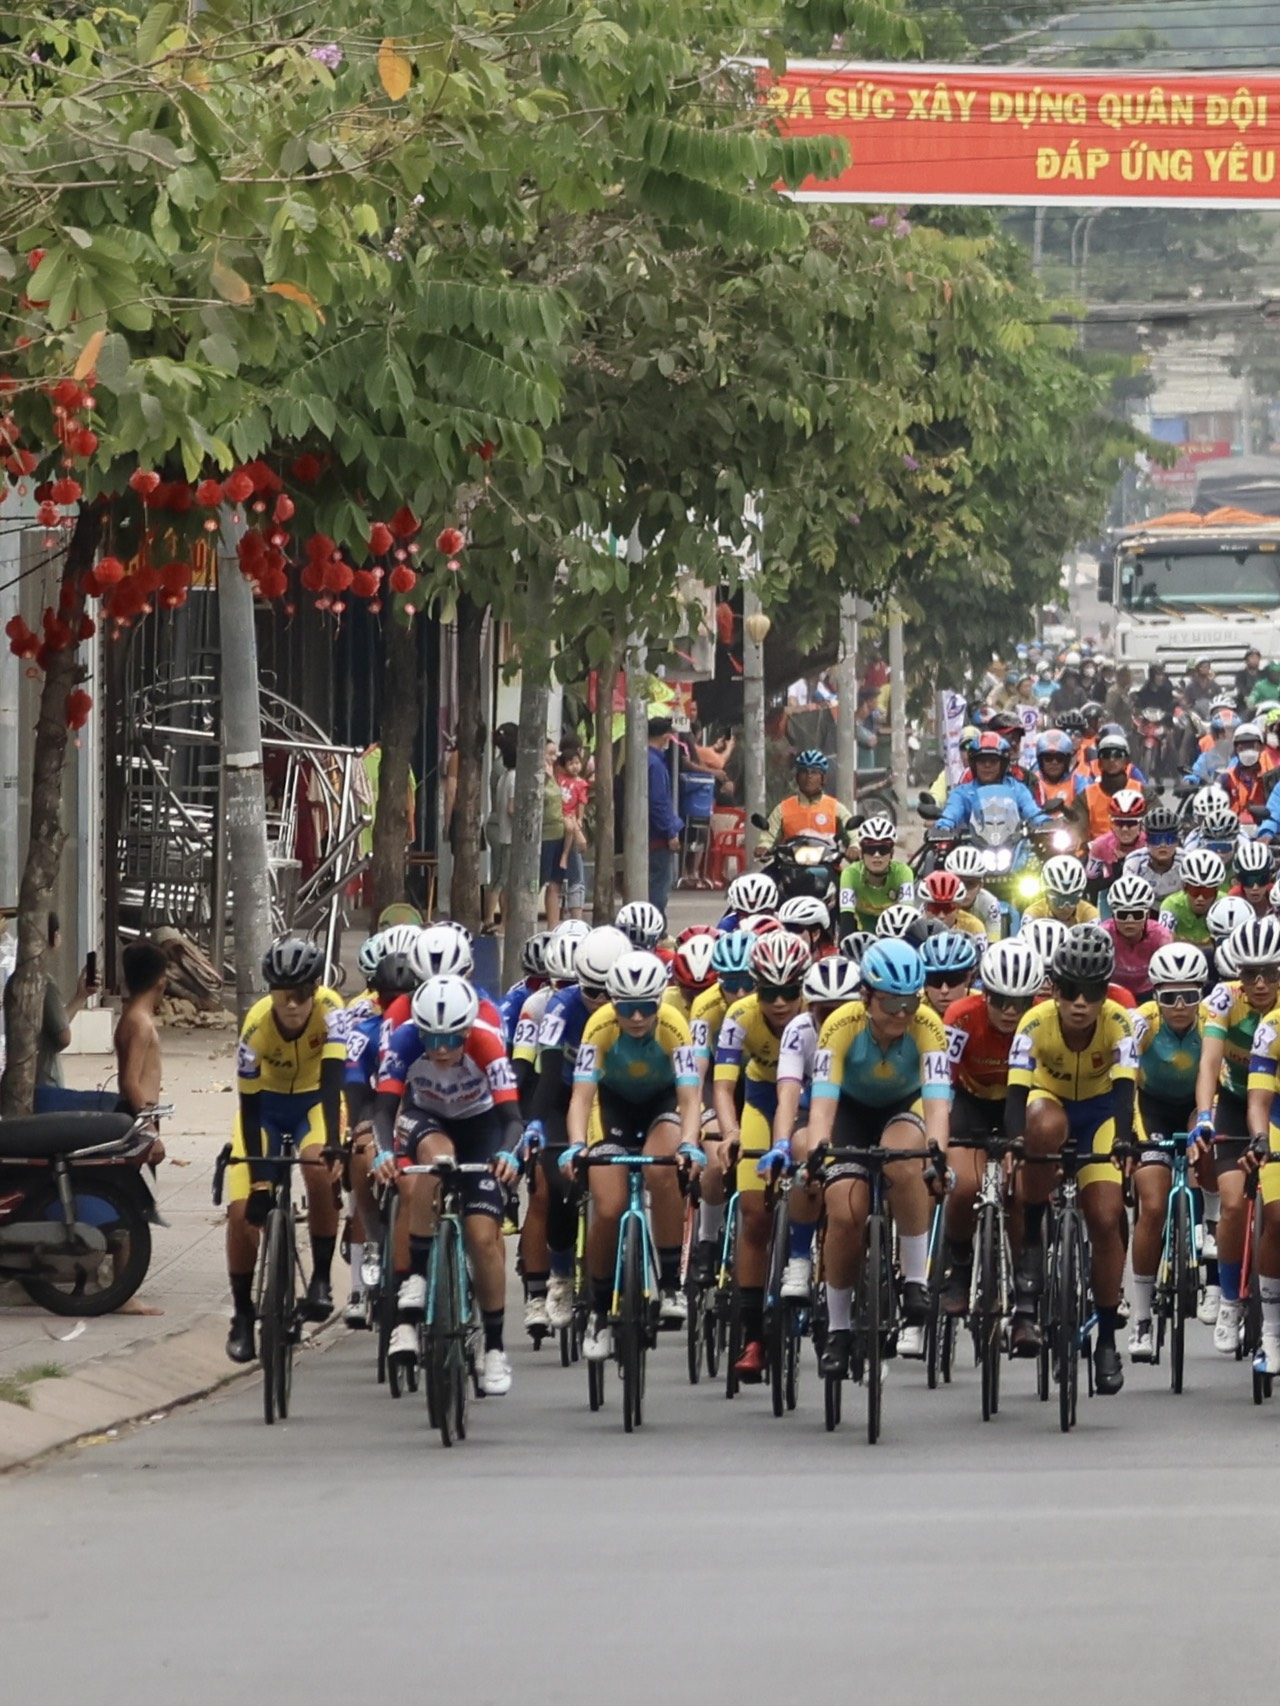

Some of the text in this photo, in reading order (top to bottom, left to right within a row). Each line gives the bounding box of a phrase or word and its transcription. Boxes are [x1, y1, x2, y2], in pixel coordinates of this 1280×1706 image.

[824, 81, 895, 120] SỨC
[908, 82, 978, 123] XÂY
[990, 86, 1087, 129] DỰNG
[1098, 87, 1194, 131] QUÂN
[1206, 87, 1267, 134] ĐỘI
[1036, 139, 1110, 180] ĐÁP
[1121, 140, 1193, 182] ỨNG
[1204, 140, 1275, 183] YÊU
[1209, 986, 1231, 1011] 23
[515, 1022, 536, 1043] 92
[726, 1027, 736, 1046] 1
[1254, 1027, 1266, 1050] 3
